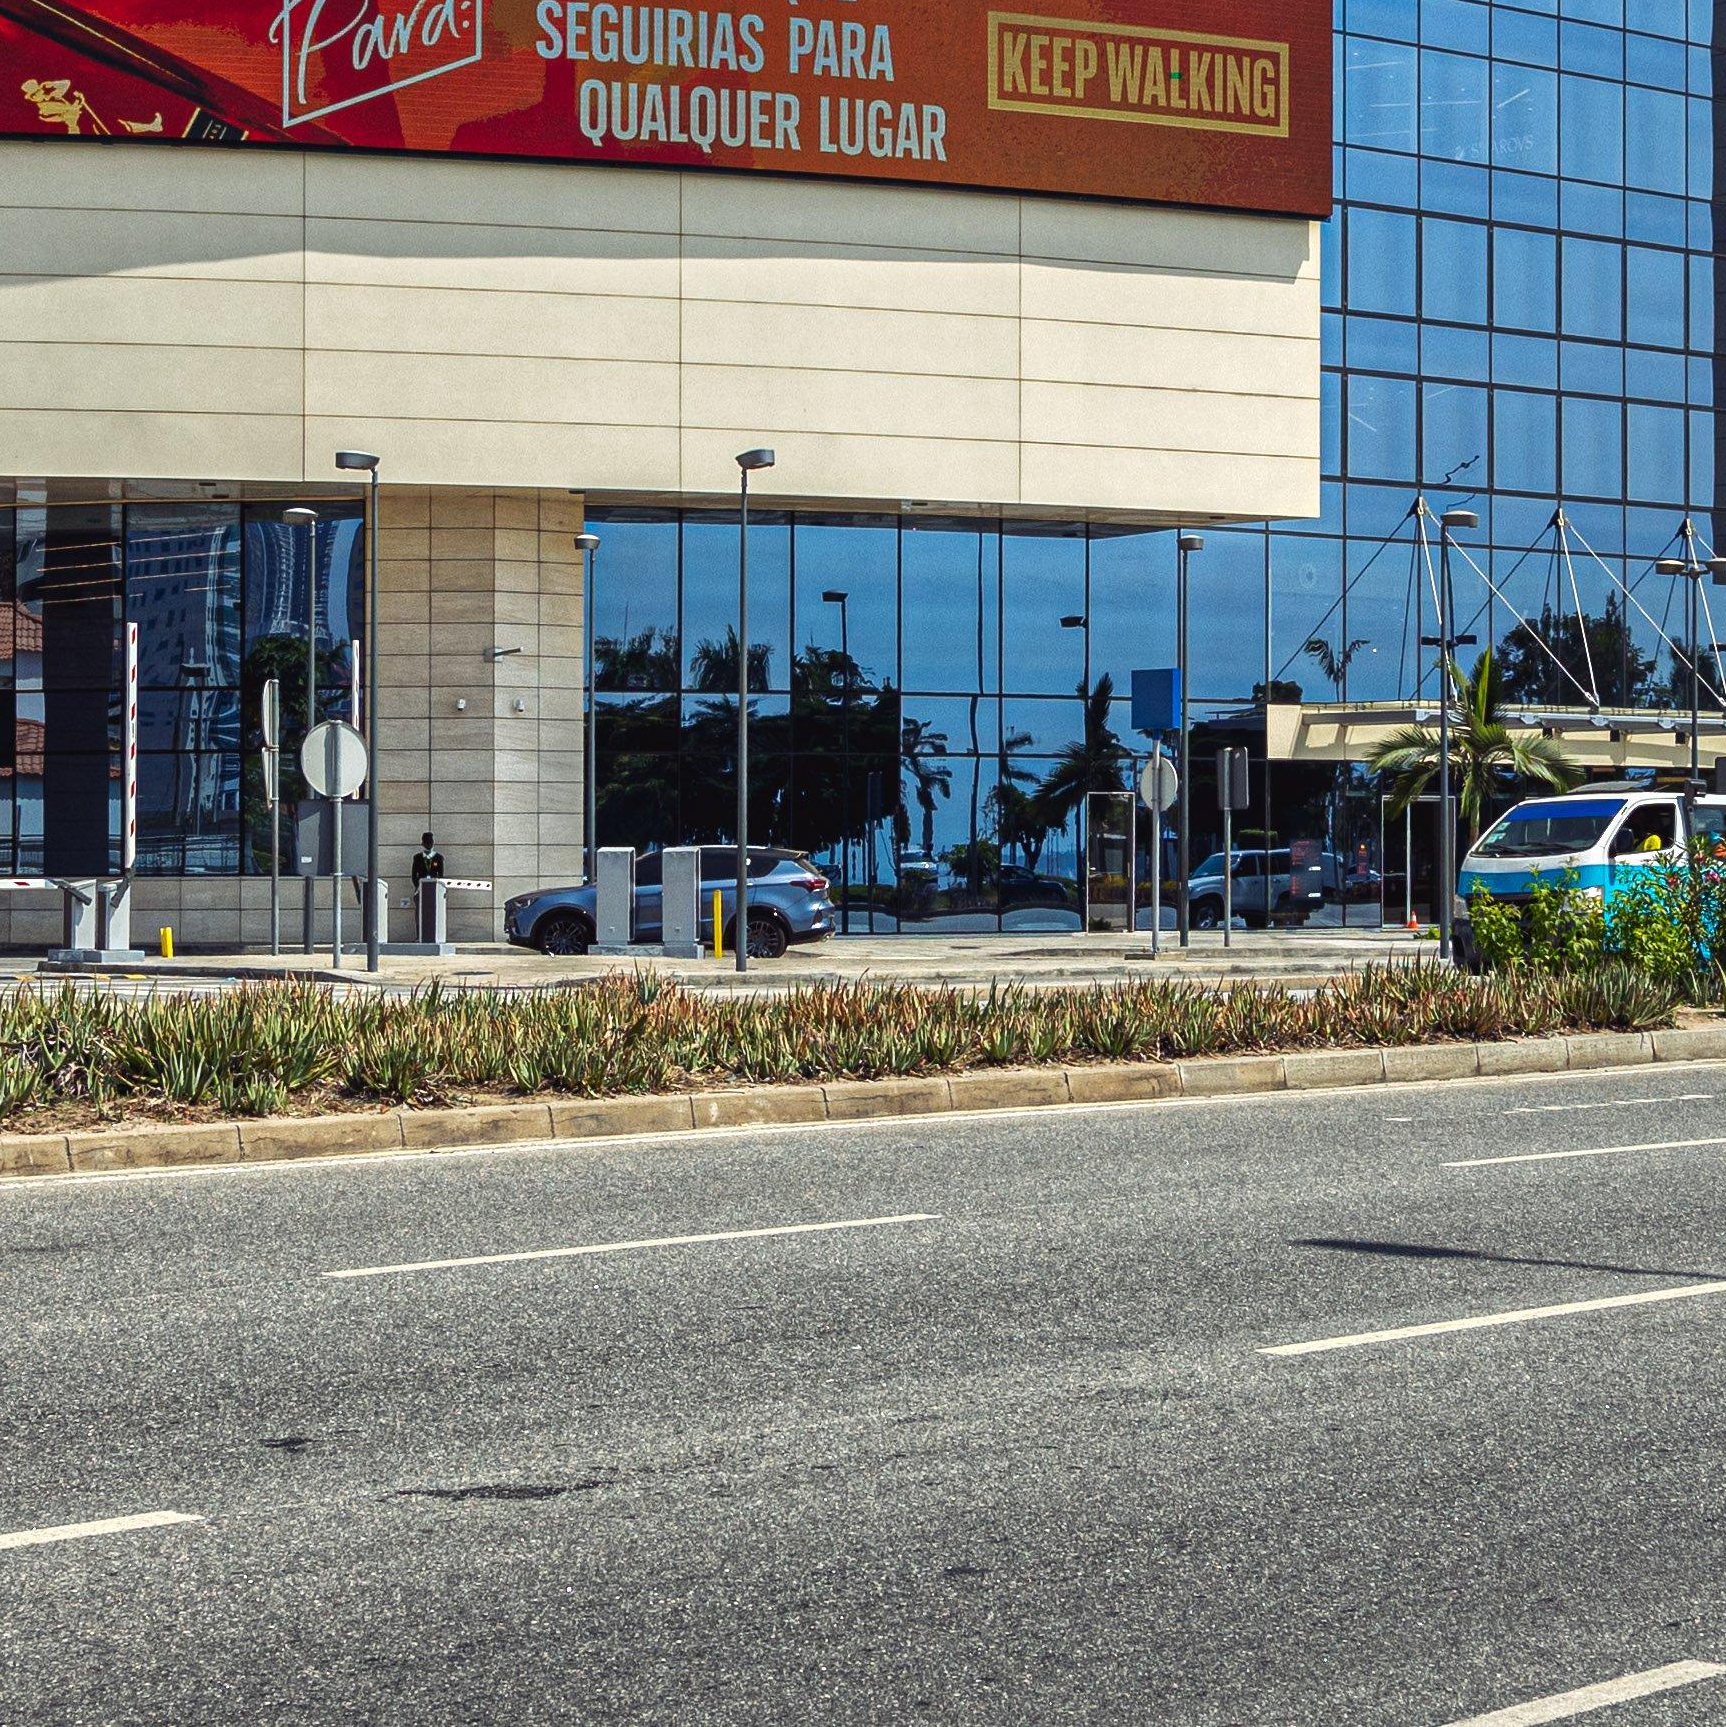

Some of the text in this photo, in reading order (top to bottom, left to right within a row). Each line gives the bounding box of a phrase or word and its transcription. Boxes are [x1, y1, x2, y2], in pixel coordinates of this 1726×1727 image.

[535, 0, 894, 82] SEGUIRIAS PARA
[1003, 31, 1276, 119] KEEP WALKING
[580, 79, 948, 162] QUALQUER LUGAR
